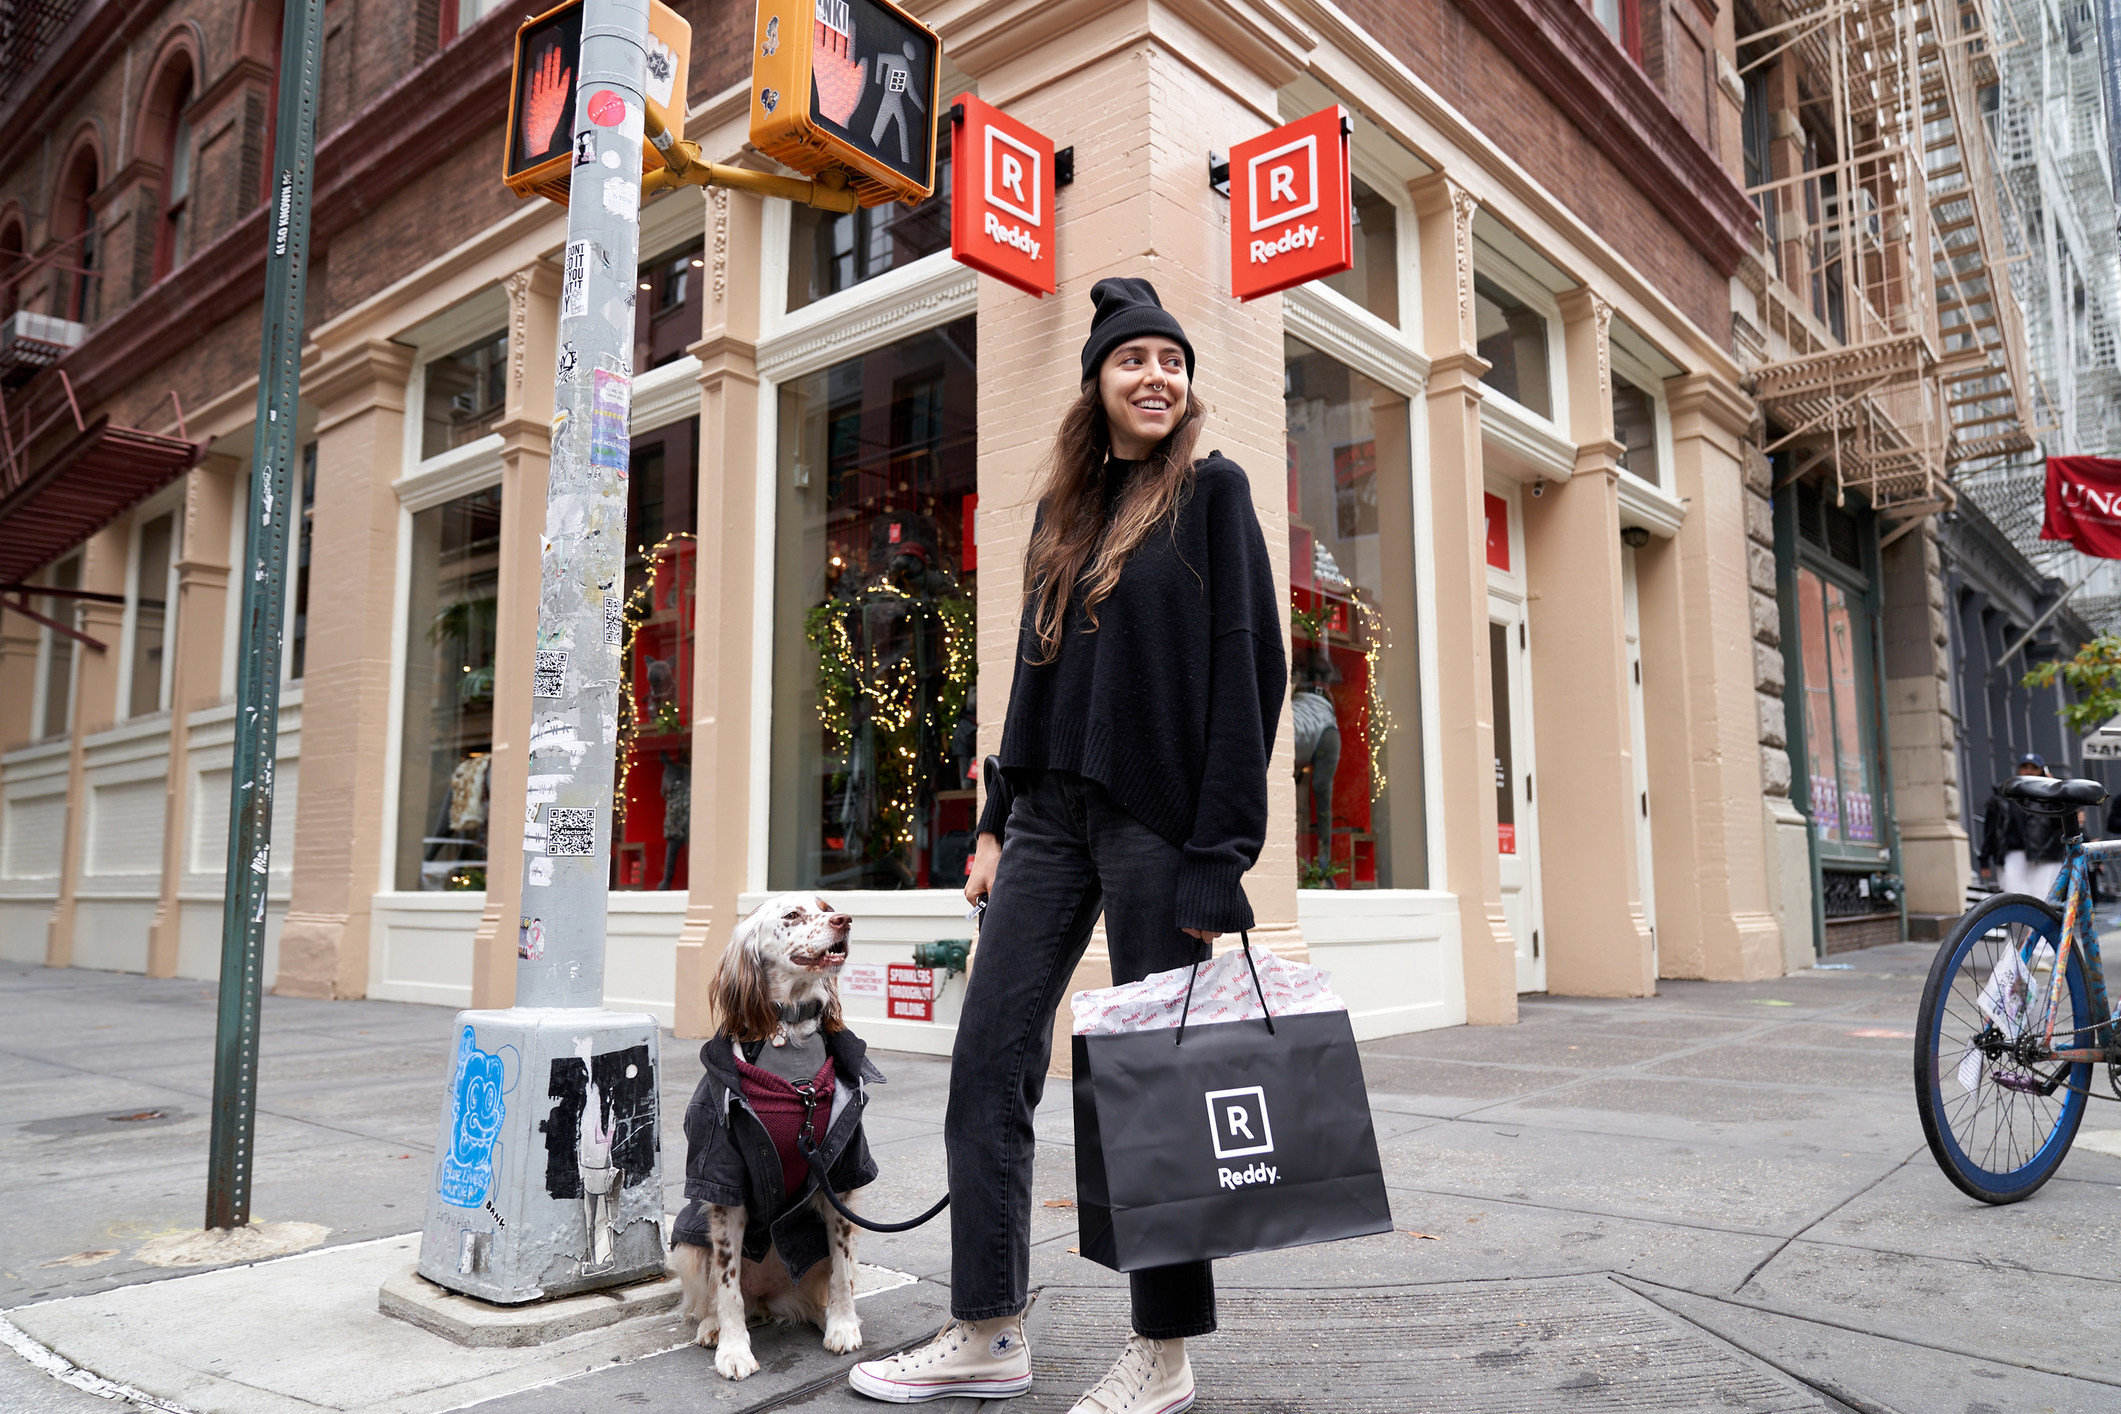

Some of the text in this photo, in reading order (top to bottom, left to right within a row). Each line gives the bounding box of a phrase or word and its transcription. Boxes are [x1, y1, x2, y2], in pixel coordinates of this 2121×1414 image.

[1003, 153, 1025, 202] R
[1270, 165, 1298, 202] R
[278, 186, 292, 227] KNOWN
[985, 212, 1041, 260] Reddy
[1250, 223, 1319, 264] Reddy
[1197, 961, 1216, 978] Reddy
[893, 1001, 926, 1017] BUILDING
[1101, 1003, 1120, 1017] Reddy
[1121, 1011, 1141, 1025] Reddy
[1139, 1012, 1158, 1026] Reddy
[1226, 1105, 1255, 1140] R
[1218, 1161, 1277, 1190] Reddy
